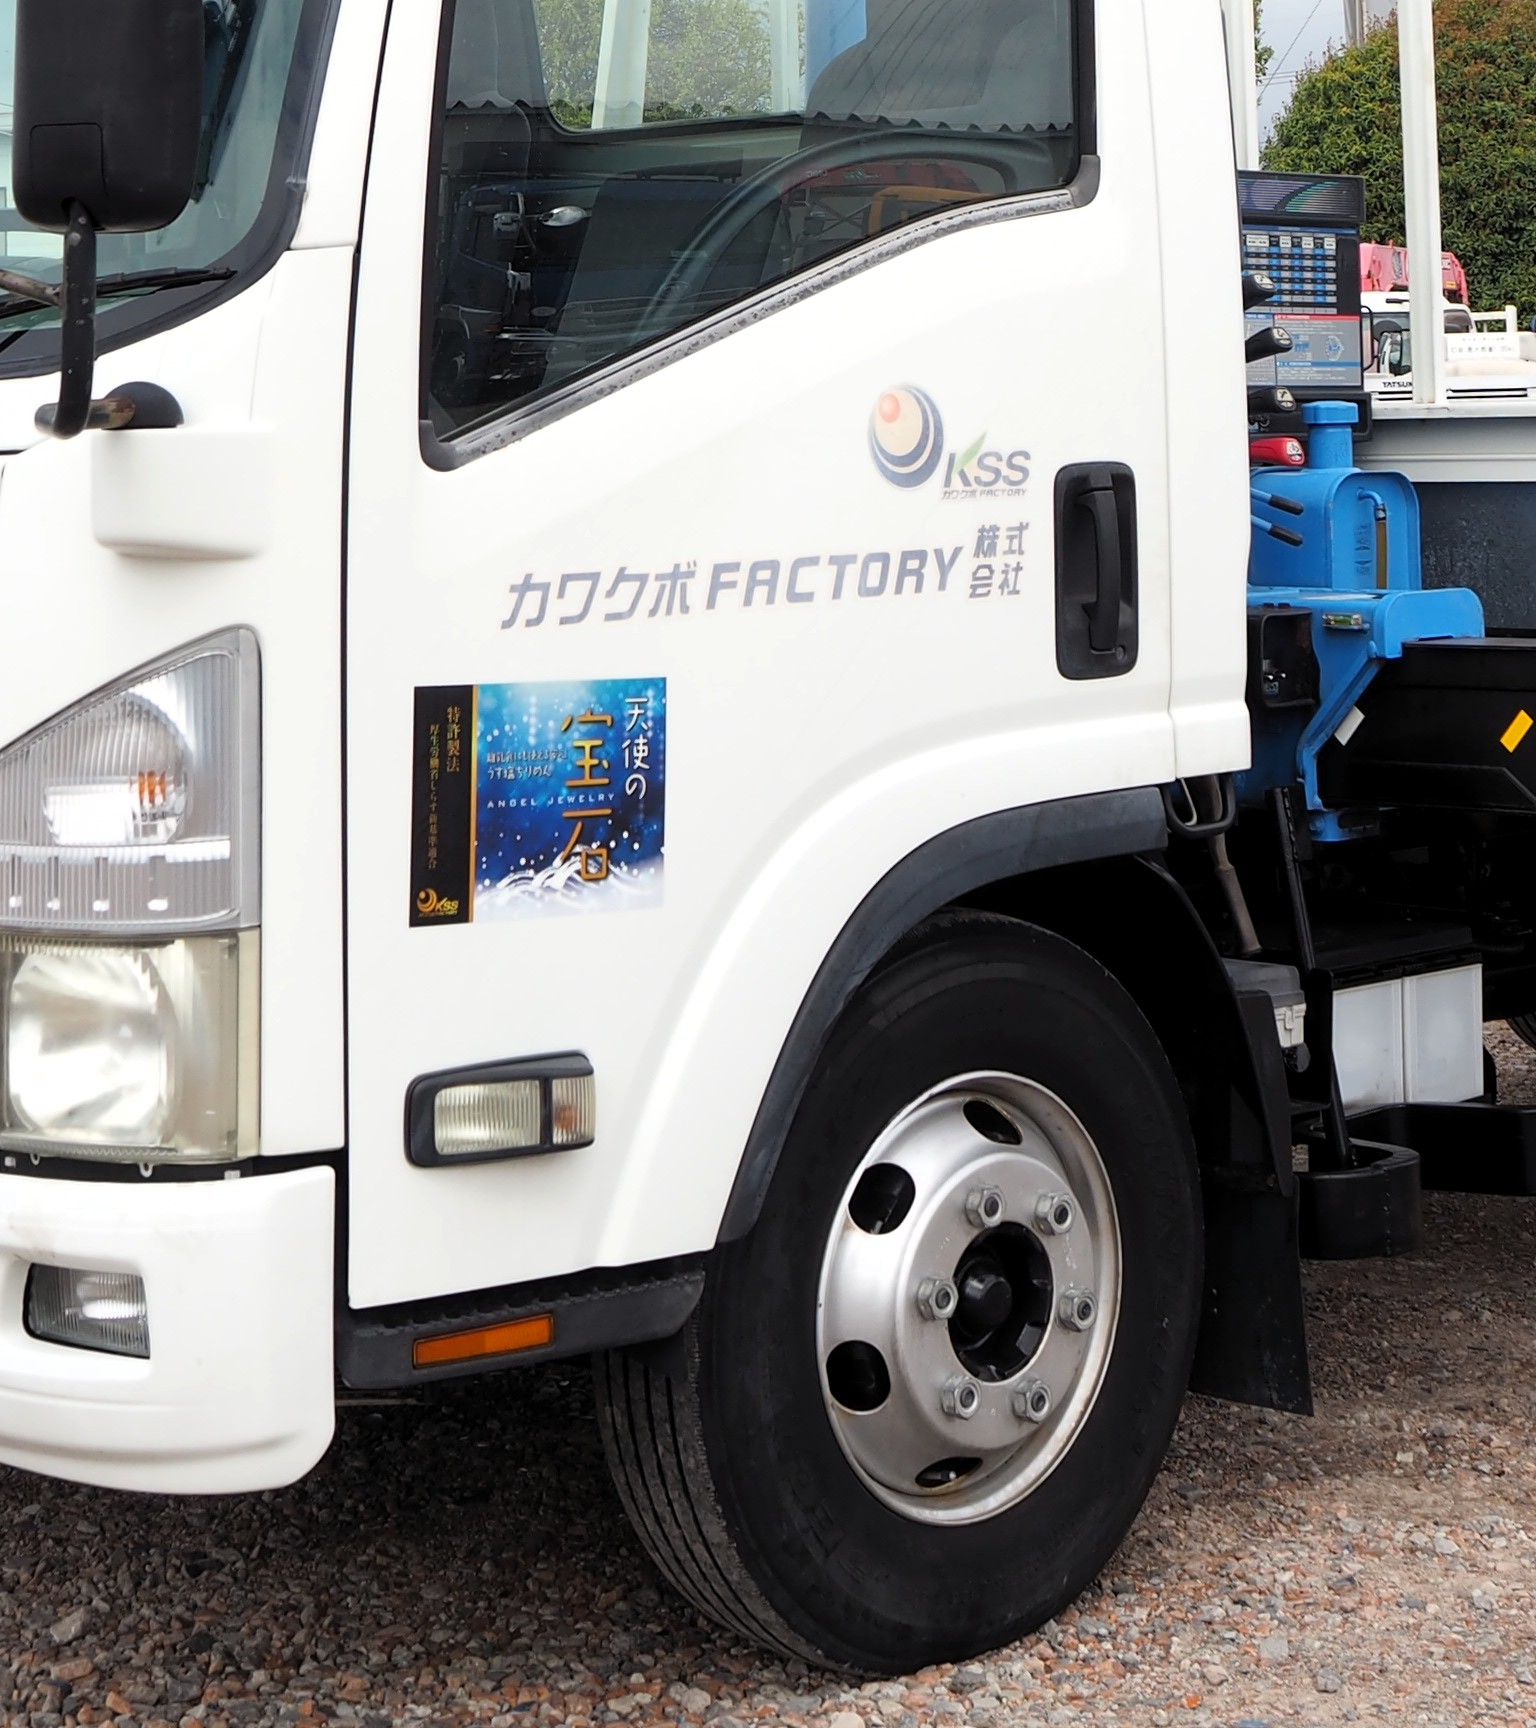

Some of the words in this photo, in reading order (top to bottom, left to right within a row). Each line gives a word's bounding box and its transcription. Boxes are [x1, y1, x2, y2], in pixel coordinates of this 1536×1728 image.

[943, 435, 1032, 488] KSS
[972, 521, 1031, 560] 株式
[968, 560, 1024, 600] 会社
[445, 704, 463, 773] 特許製法
[621, 695, 652, 802] 天使の
[547, 792, 617, 806] JEWELRY
[560, 708, 614, 882] 宝石
